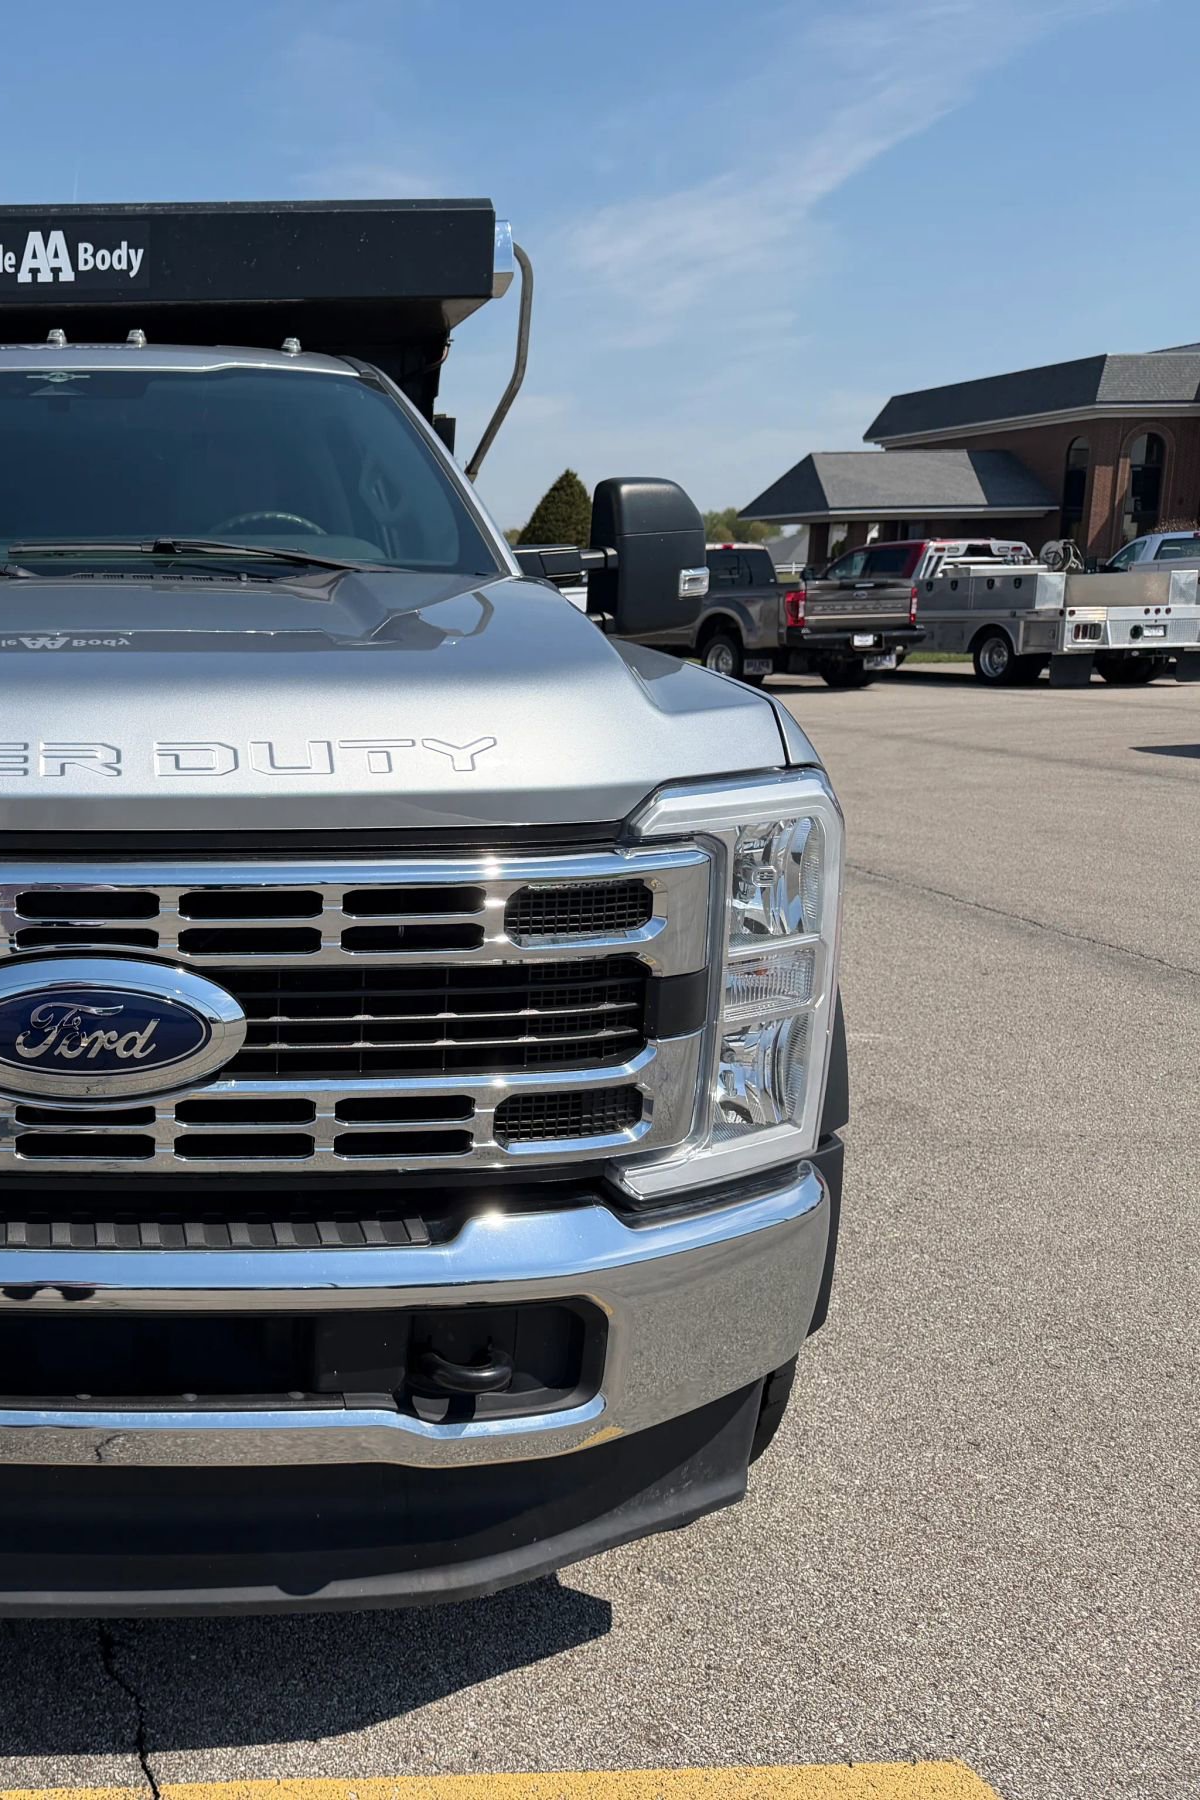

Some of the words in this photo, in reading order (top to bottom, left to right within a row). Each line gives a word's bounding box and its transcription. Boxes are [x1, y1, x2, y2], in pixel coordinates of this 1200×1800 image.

[17, 230, 75, 283] AA
[77, 240, 144, 279] Body
[154, 736, 498, 777] DUTY
[14, 1001, 161, 1059] Ford
